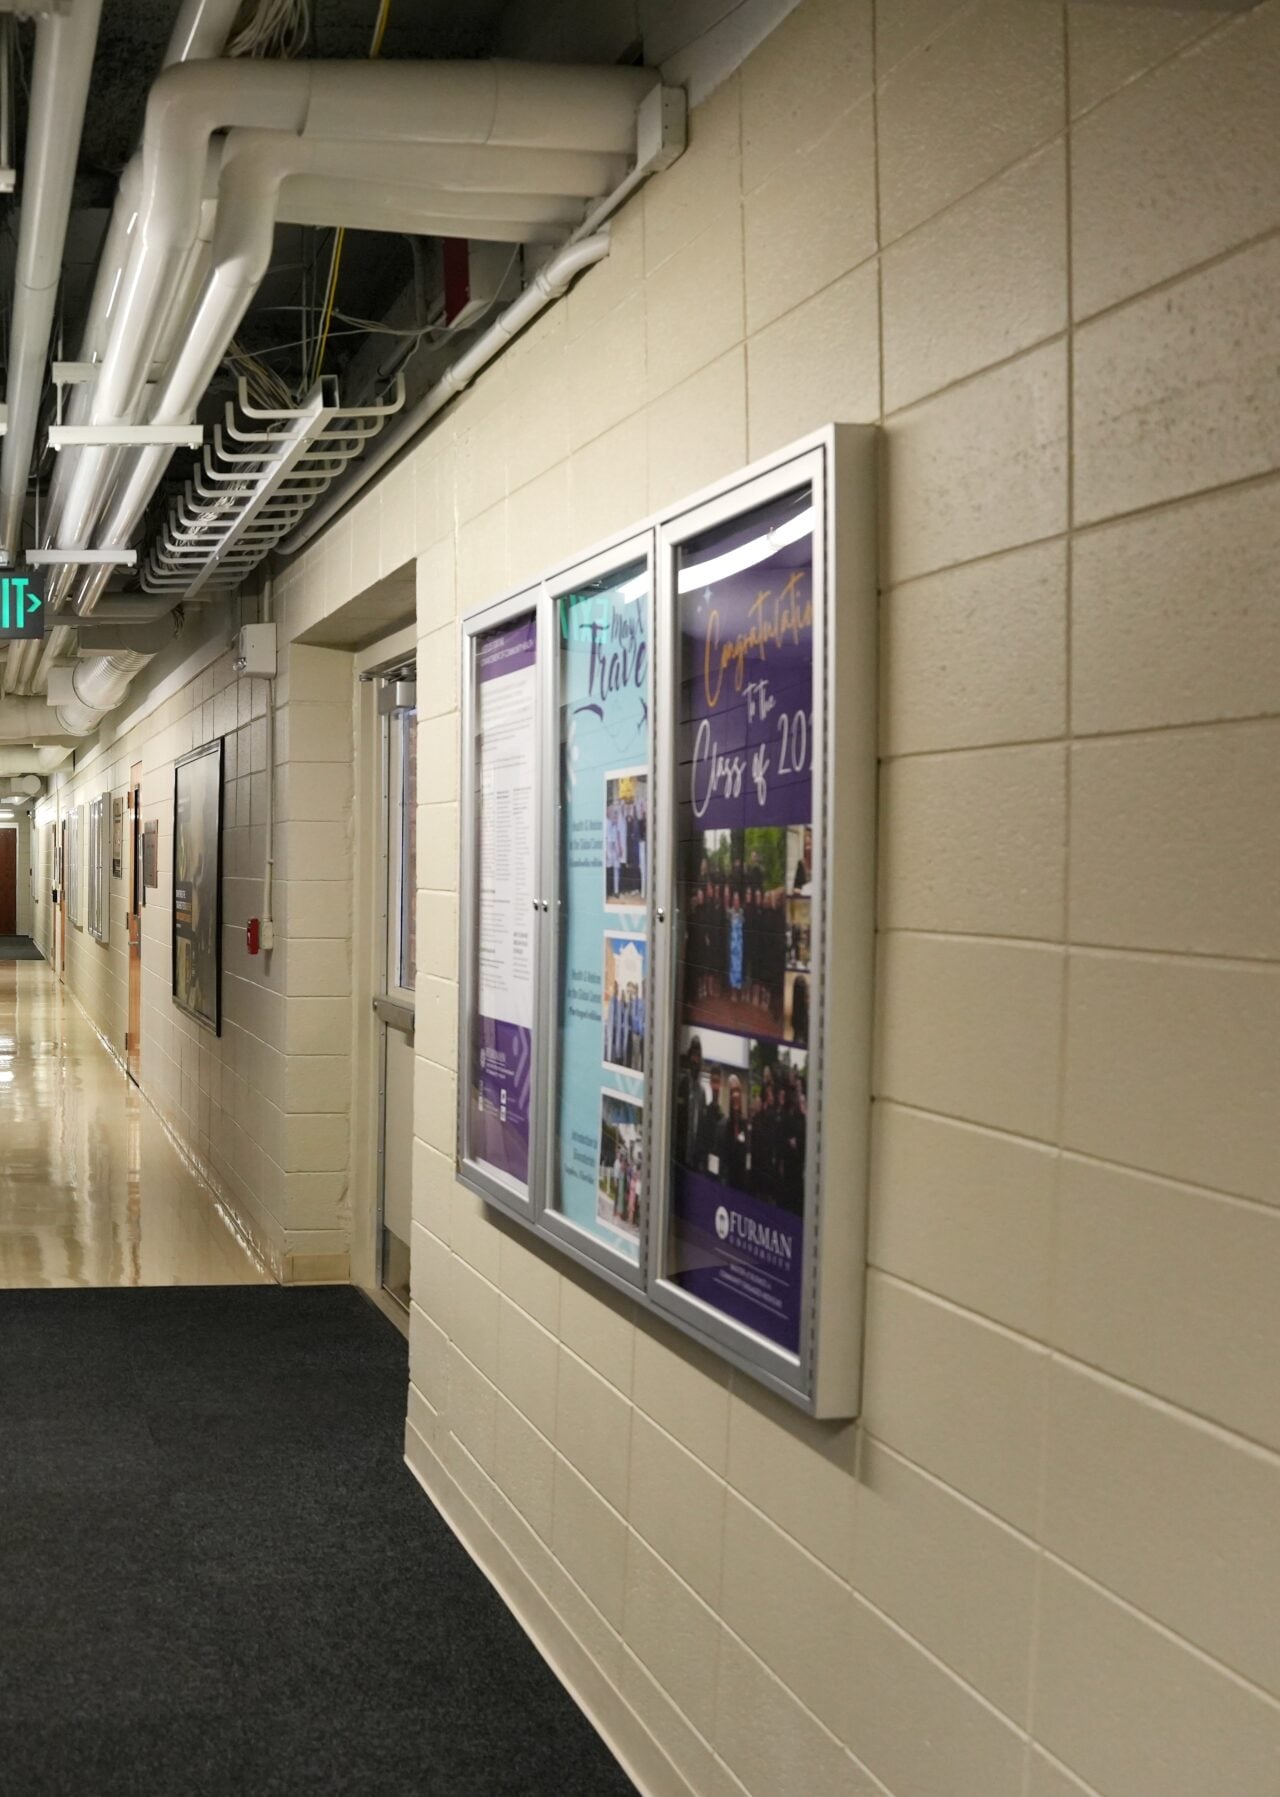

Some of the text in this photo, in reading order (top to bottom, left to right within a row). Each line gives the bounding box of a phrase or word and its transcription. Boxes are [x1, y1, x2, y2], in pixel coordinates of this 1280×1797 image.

[691, 719, 747, 818] Class
[751, 743, 770, 806] of
[729, 1210, 793, 1259] FURMAN
